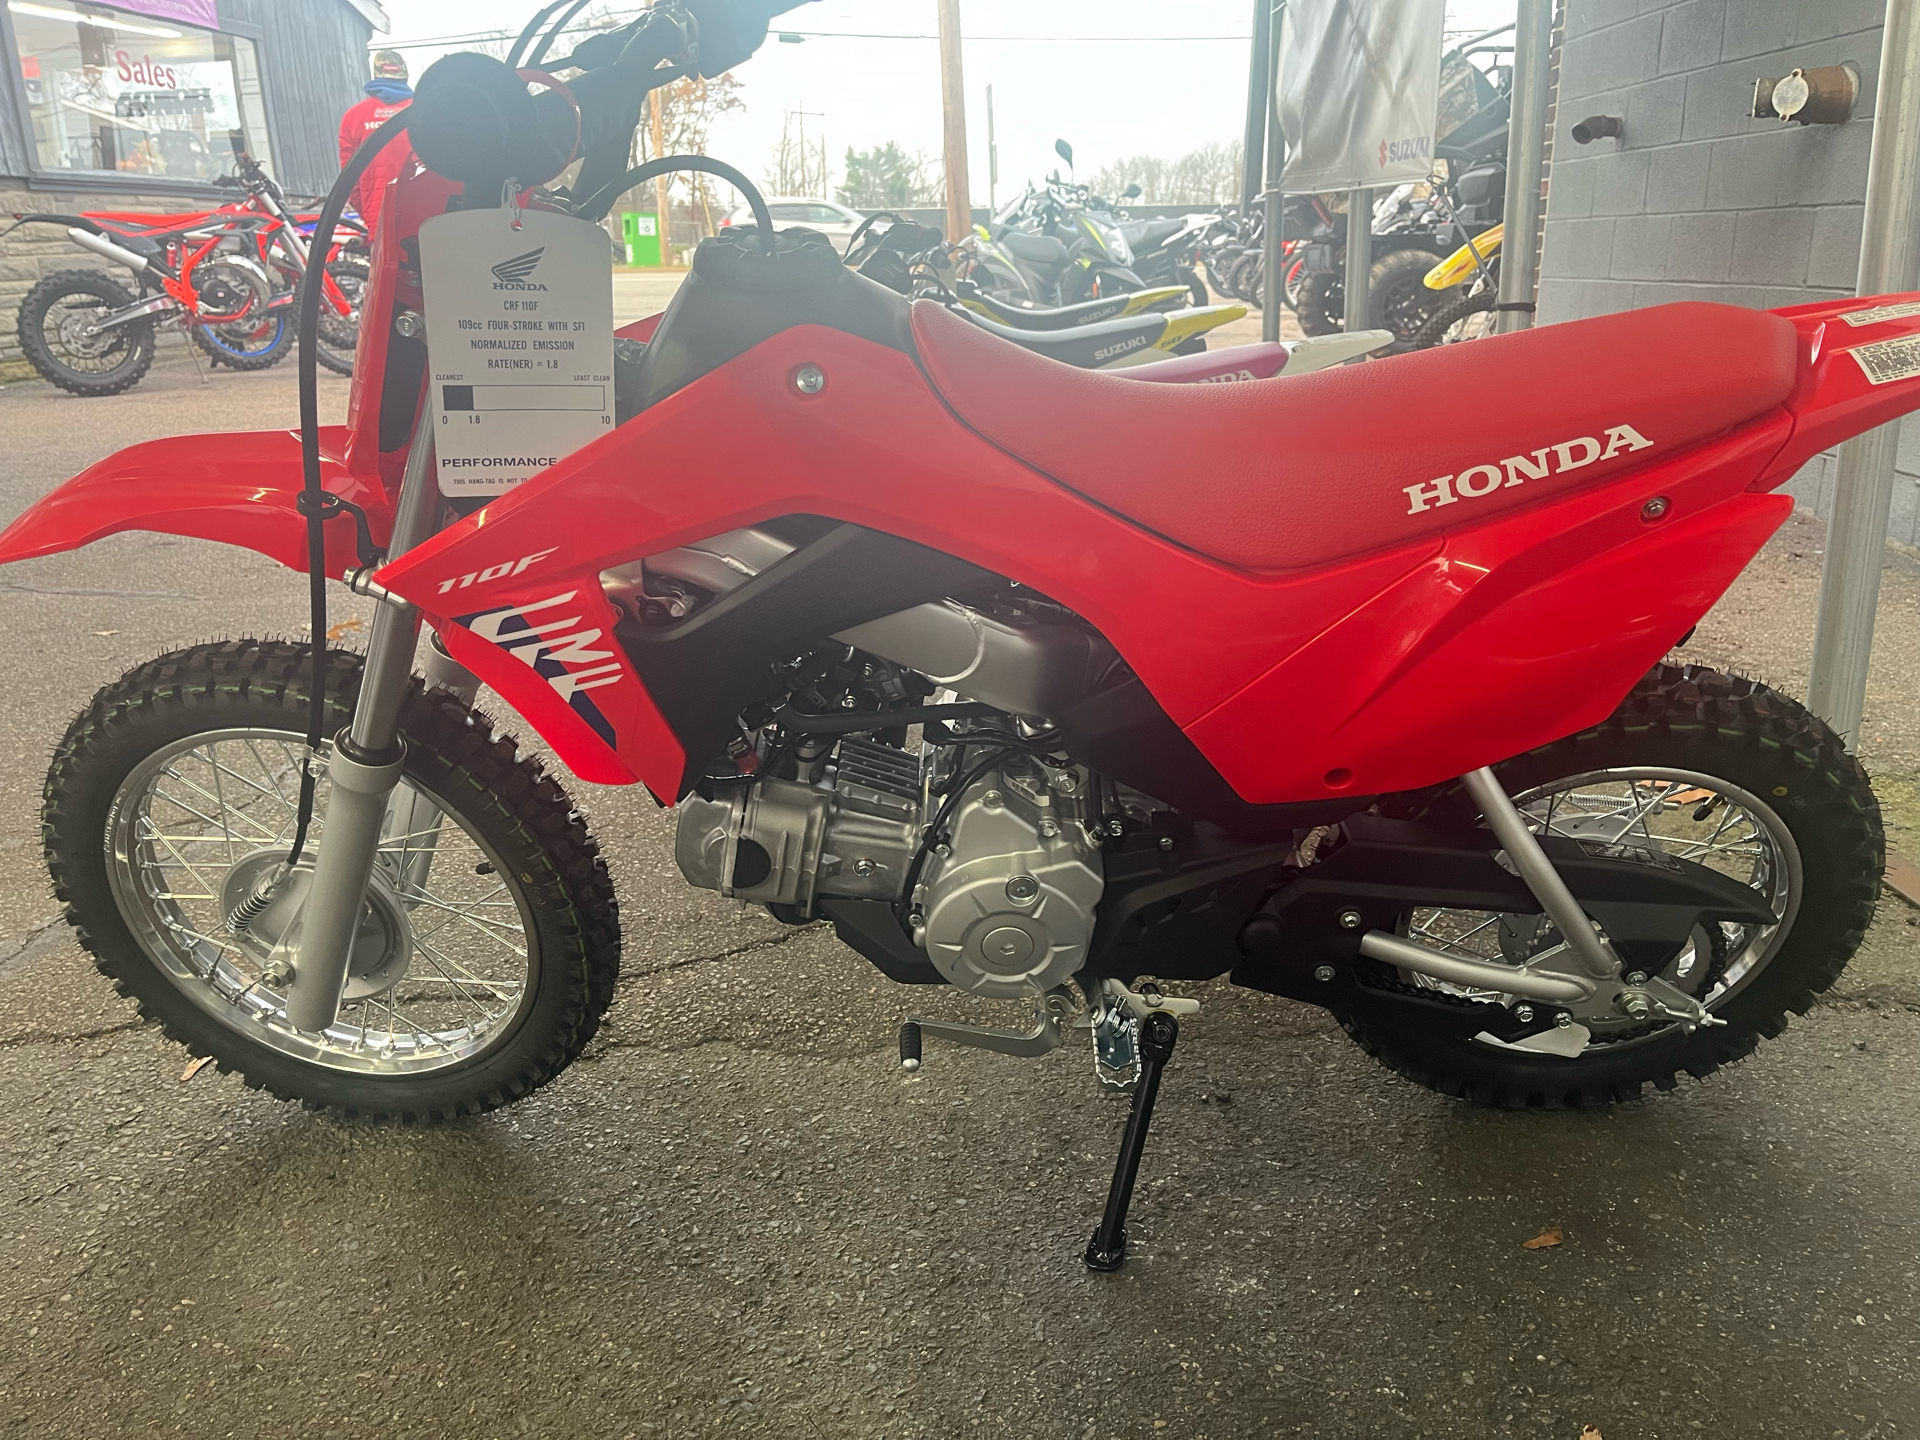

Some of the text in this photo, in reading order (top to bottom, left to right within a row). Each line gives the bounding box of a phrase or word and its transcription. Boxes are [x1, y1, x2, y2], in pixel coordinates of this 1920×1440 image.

[115, 50, 177, 90] Sales
[1389, 135, 1431, 163] SUZUKI
[492, 282, 549, 292] HONDA
[503, 301, 539, 311] CRF 110F
[1078, 306, 1117, 325] SUZUKI
[458, 320, 586, 332] 109cc FOUR-STROKE WITH SFI
[470, 339, 575, 351] NORMALIZED EMISSION
[1094, 335, 1148, 361] SUZUKI
[487, 359, 534, 370] RATE(NER)
[546, 359, 559, 370] 1.8
[442, 415, 611, 425] 0 1.8 10
[442, 457, 558, 468] PERFORMANCE
[1403, 424, 1655, 516] HONDA
[437, 546, 560, 595] 110F
[468, 589, 624, 704] CRF
